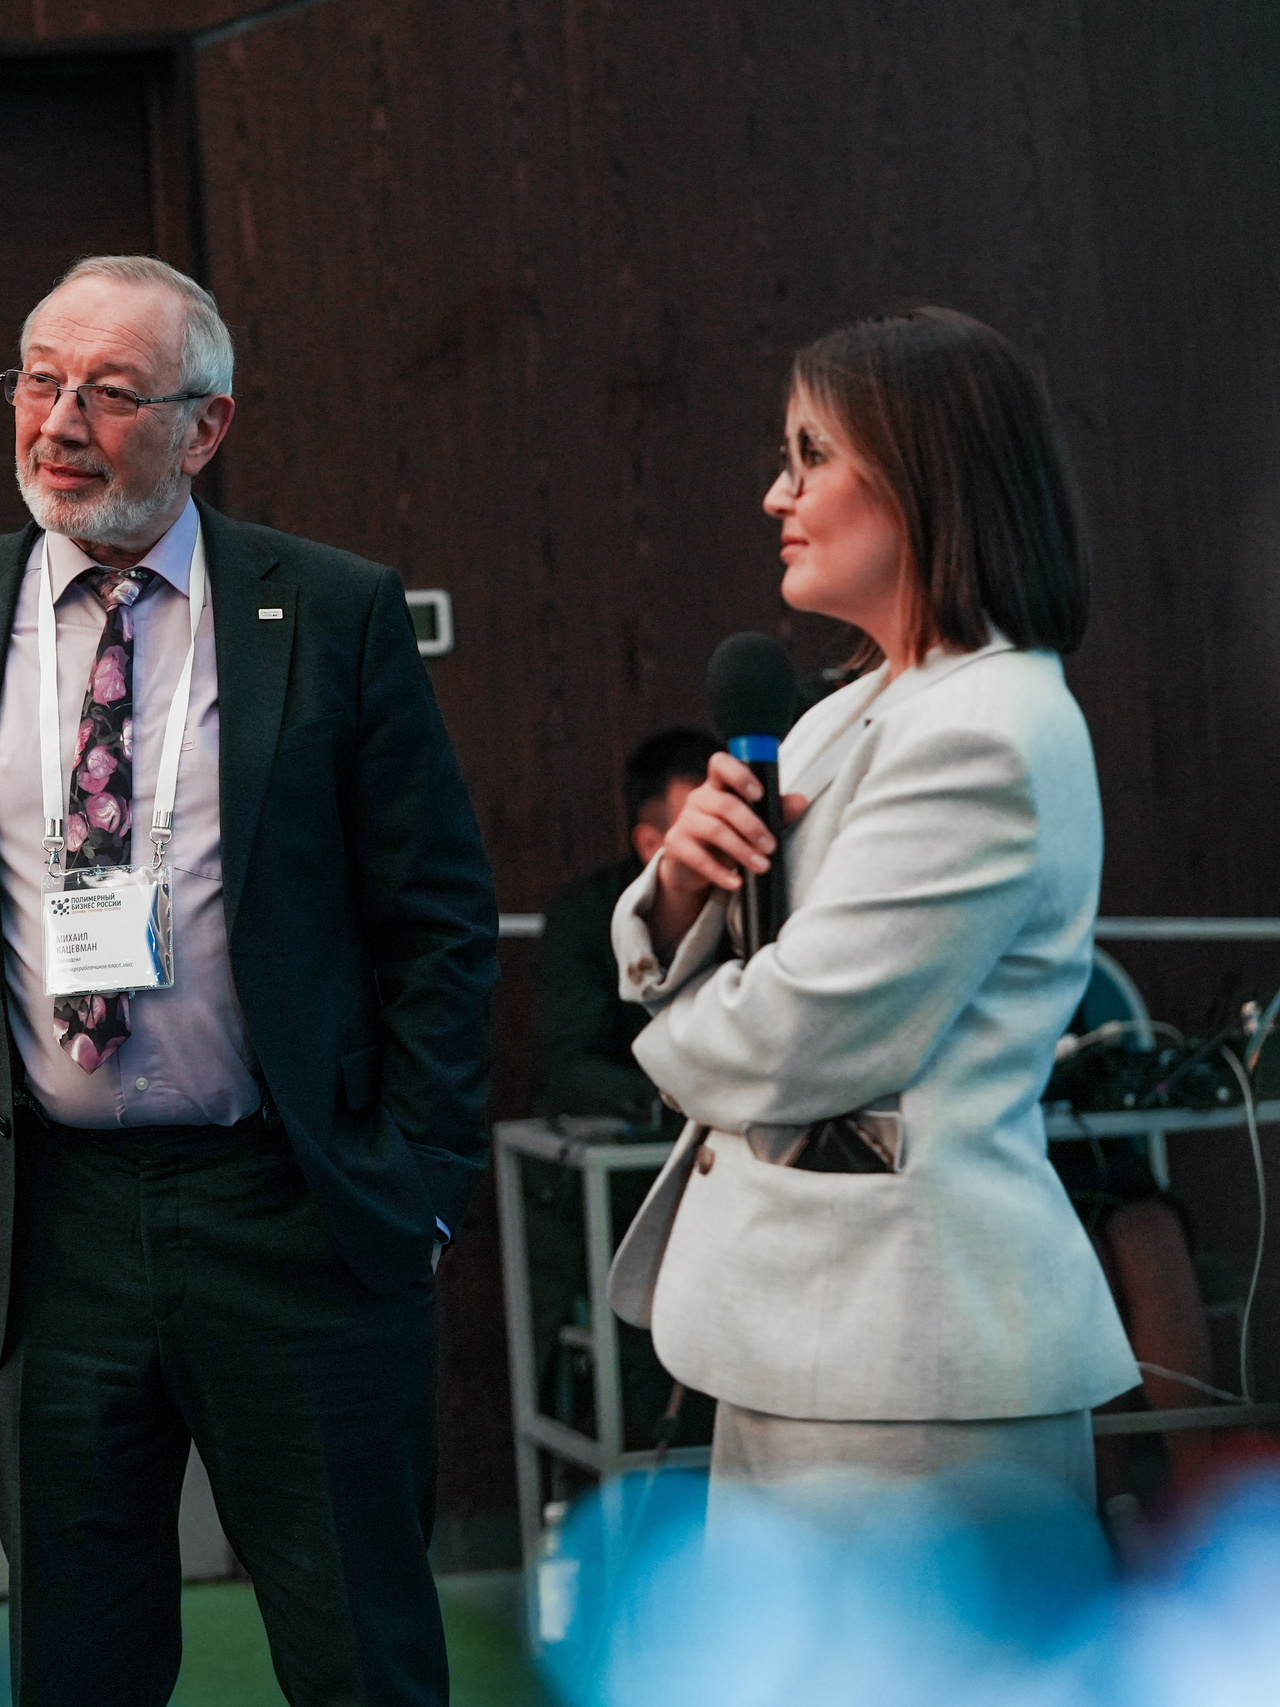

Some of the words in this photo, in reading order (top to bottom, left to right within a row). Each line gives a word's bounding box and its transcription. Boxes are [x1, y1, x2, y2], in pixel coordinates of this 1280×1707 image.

[71, 893, 115, 903] ПОЛИМЕРНЫЙ
[71, 902, 96, 910] БИЗНЕС
[96, 900, 122, 908] РОССИИ
[56, 932, 88, 943] МИХАИЛ
[56, 943, 97, 954] КАЦЕВМАН
